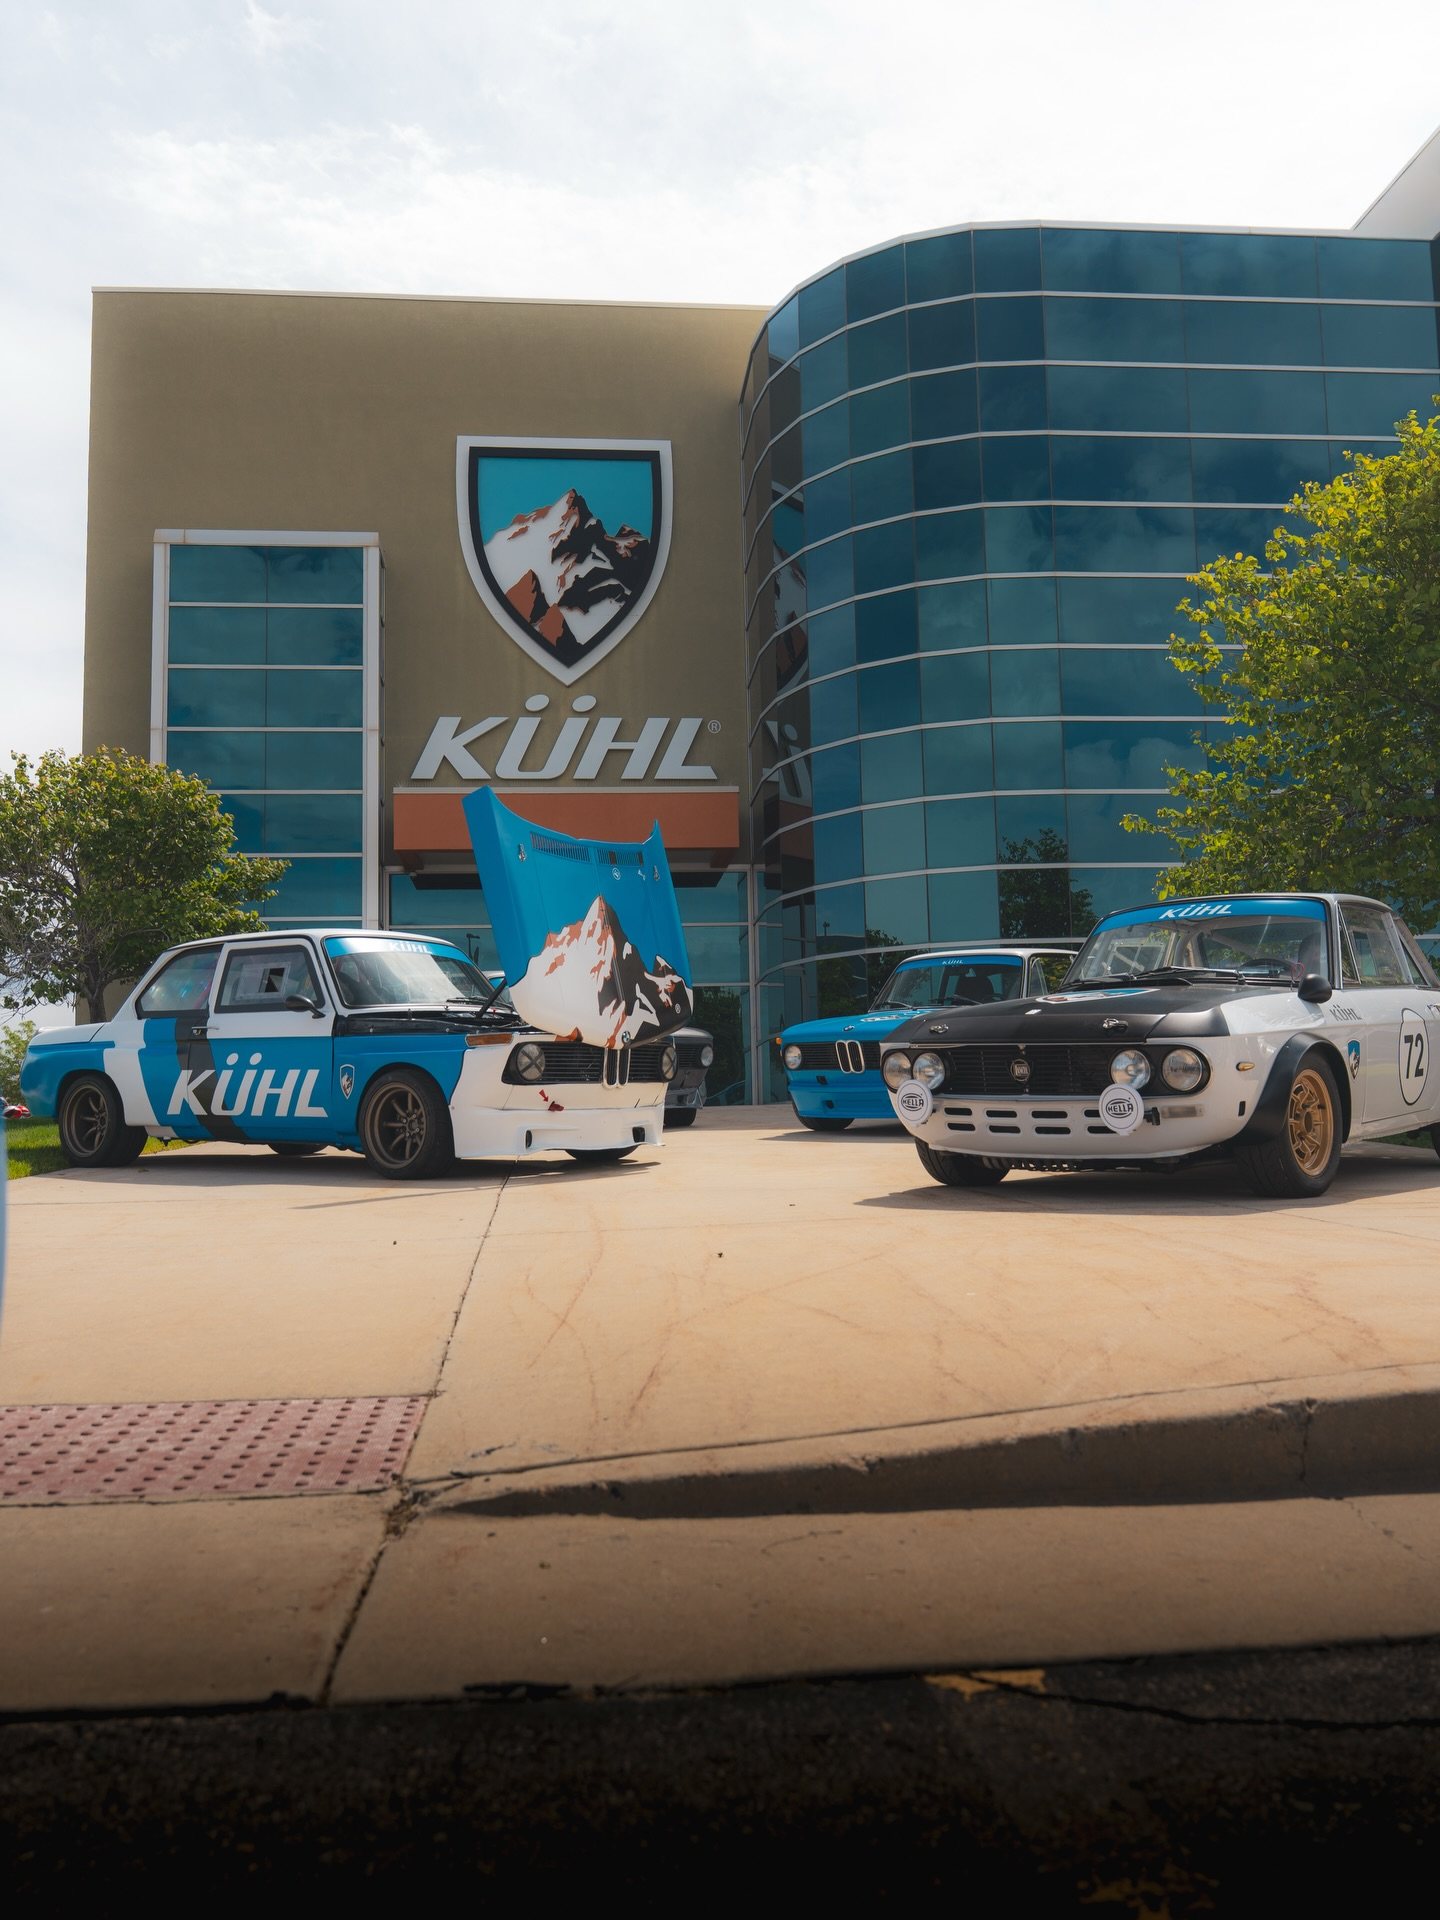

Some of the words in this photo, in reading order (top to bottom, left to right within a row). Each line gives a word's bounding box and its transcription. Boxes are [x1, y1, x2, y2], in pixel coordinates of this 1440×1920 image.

[1158, 903, 1232, 919] KÜHL
[389, 941, 432, 954] KÜHL
[1329, 1005, 1362, 1021] KÜHL
[1404, 1033, 1424, 1079] 72
[166, 1052, 329, 1118] KÜHL
[902, 1098, 924, 1107] HELLA
[1107, 1103, 1134, 1113] HELLA
